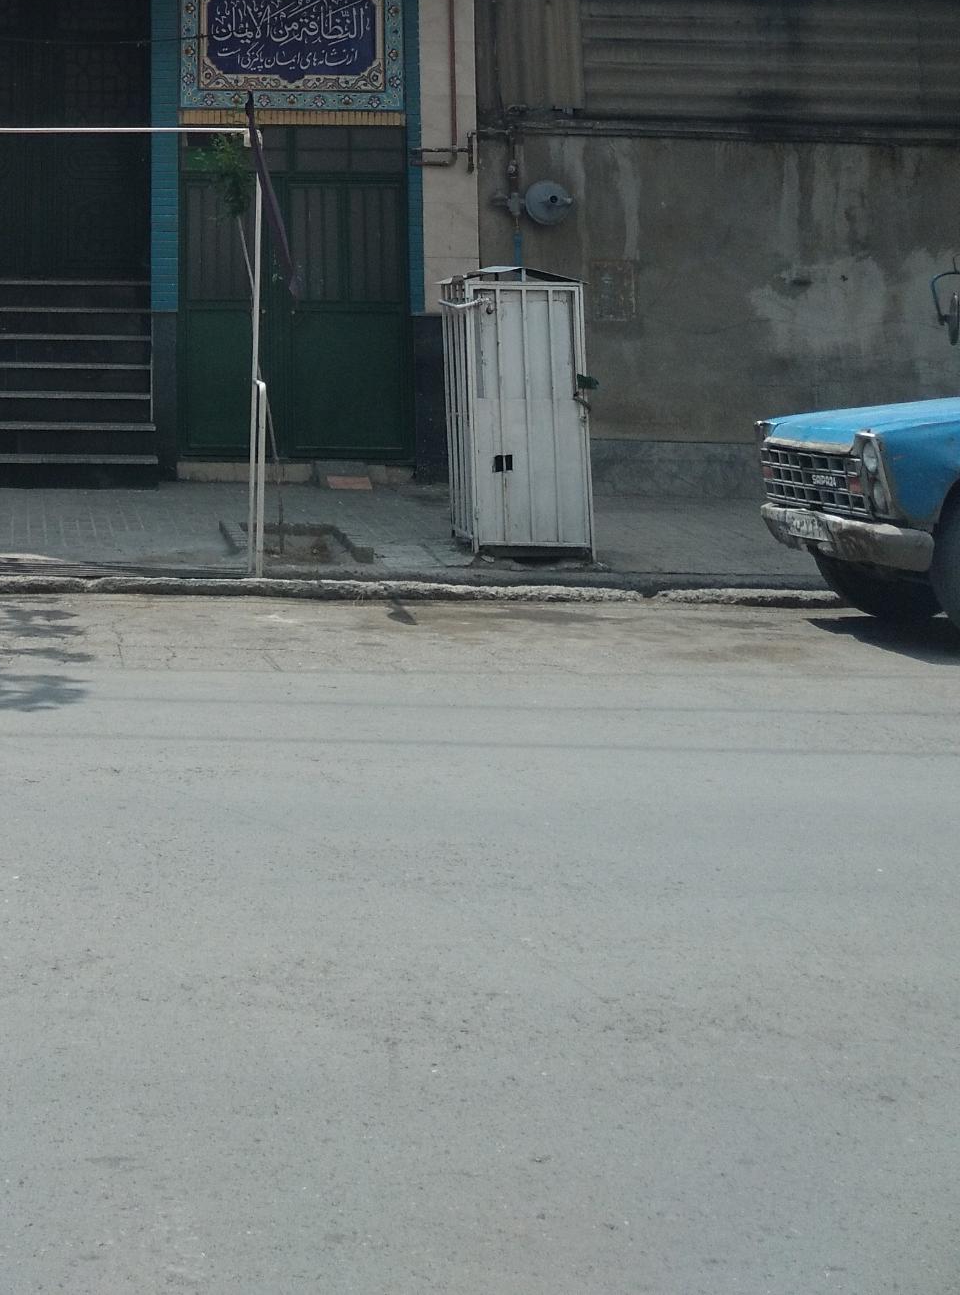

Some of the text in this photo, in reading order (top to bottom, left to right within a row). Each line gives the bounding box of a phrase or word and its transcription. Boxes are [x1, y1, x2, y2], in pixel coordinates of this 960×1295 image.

[270, 20, 299, 42] من
[218, 42, 358, 71] از نشانه های ایمان پاکیزگی است
